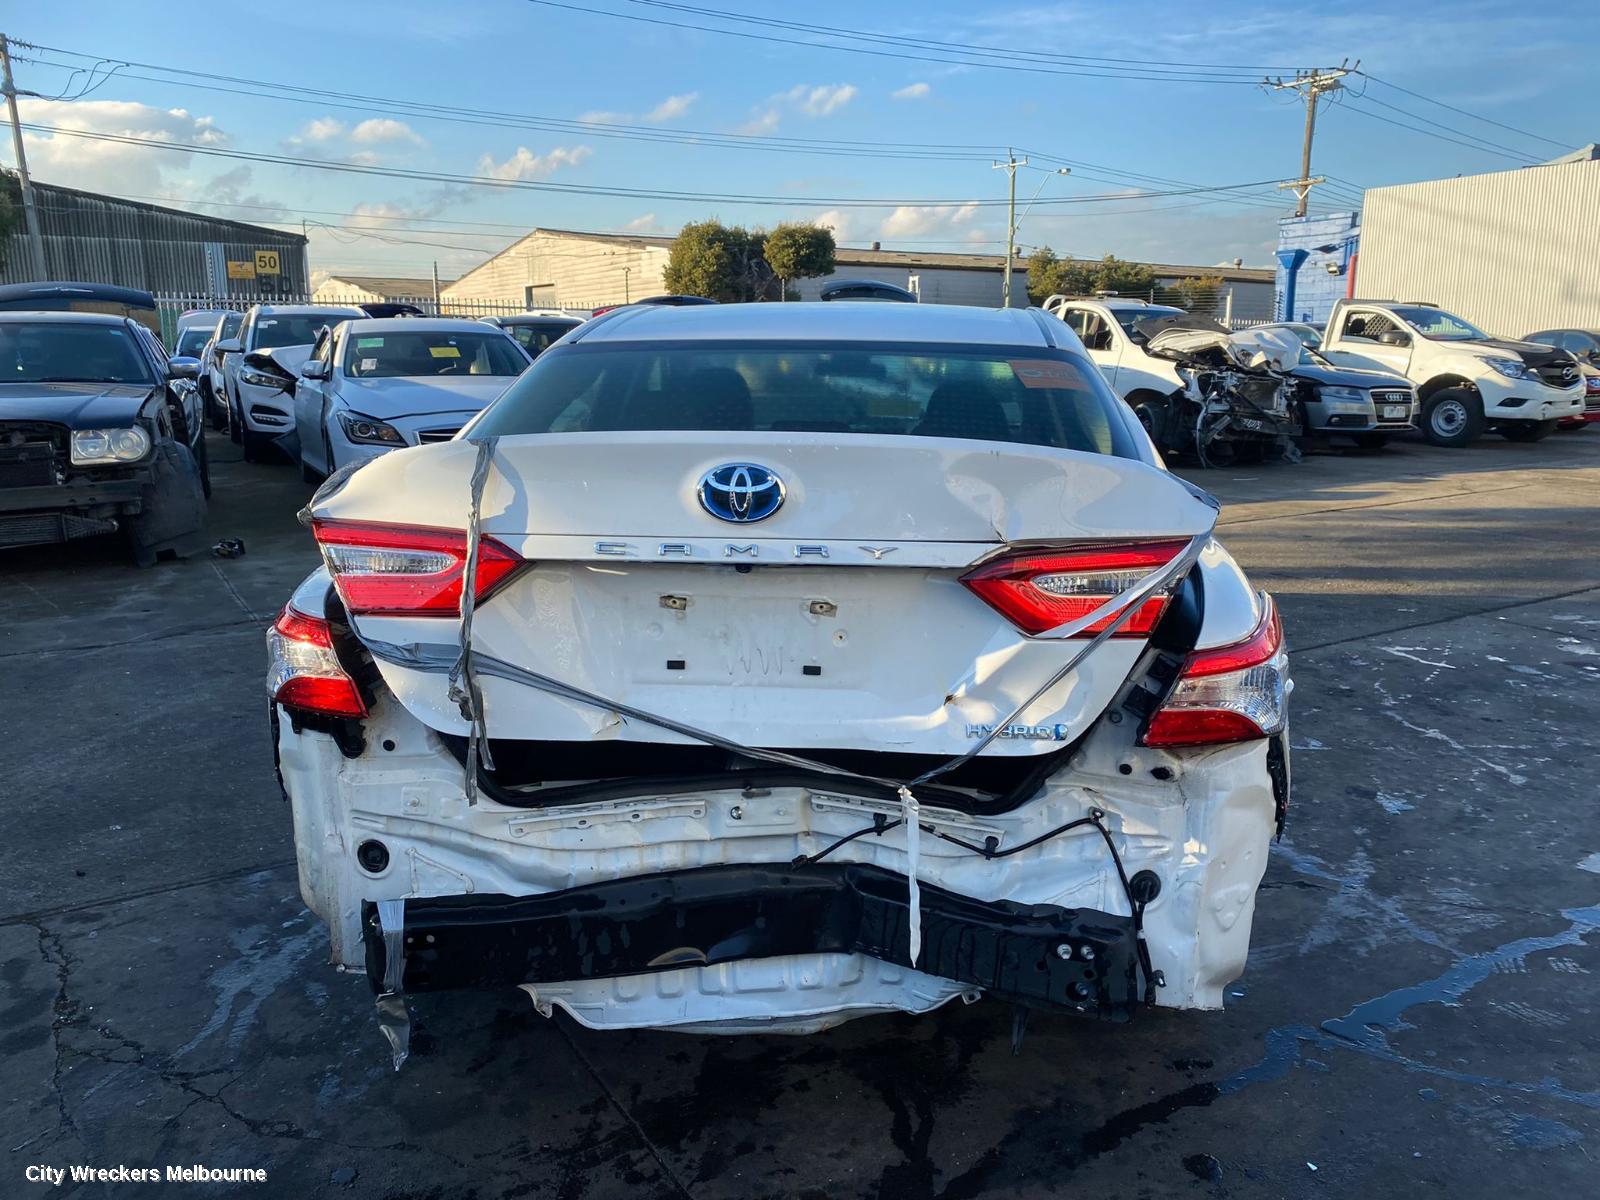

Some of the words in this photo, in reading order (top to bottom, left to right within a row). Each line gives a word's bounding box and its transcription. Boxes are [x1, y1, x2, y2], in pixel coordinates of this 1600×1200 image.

[258, 255, 277, 269] 50
[593, 541, 899, 560] CAMRY
[965, 723, 1051, 740] HYBRID
